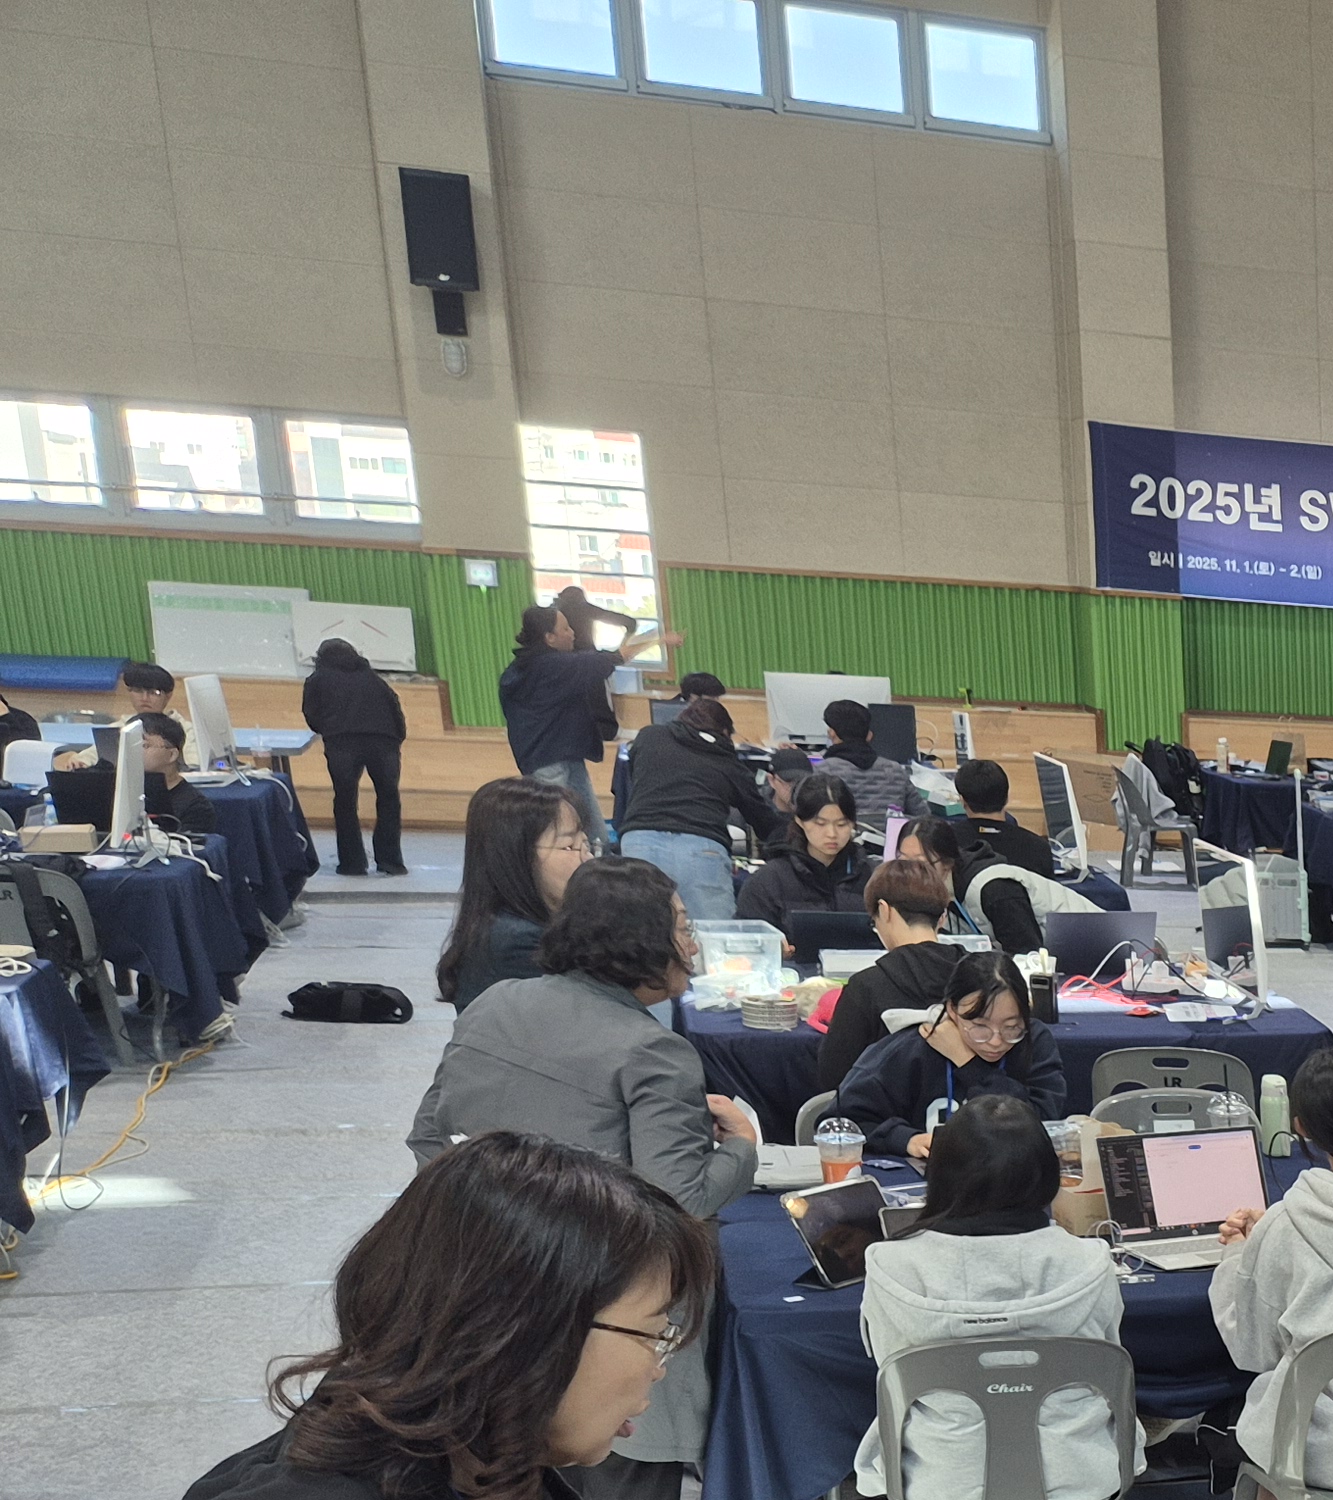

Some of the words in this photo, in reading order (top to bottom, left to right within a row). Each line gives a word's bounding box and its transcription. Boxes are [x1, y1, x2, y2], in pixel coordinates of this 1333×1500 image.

[1129, 473, 1283, 532] 2025년
[1148, 550, 1174, 568] 일시
[1187, 555, 1221, 571] 2025.
[1224, 558, 1240, 573] 11.
[986, 1383, 1034, 1394] Chair
